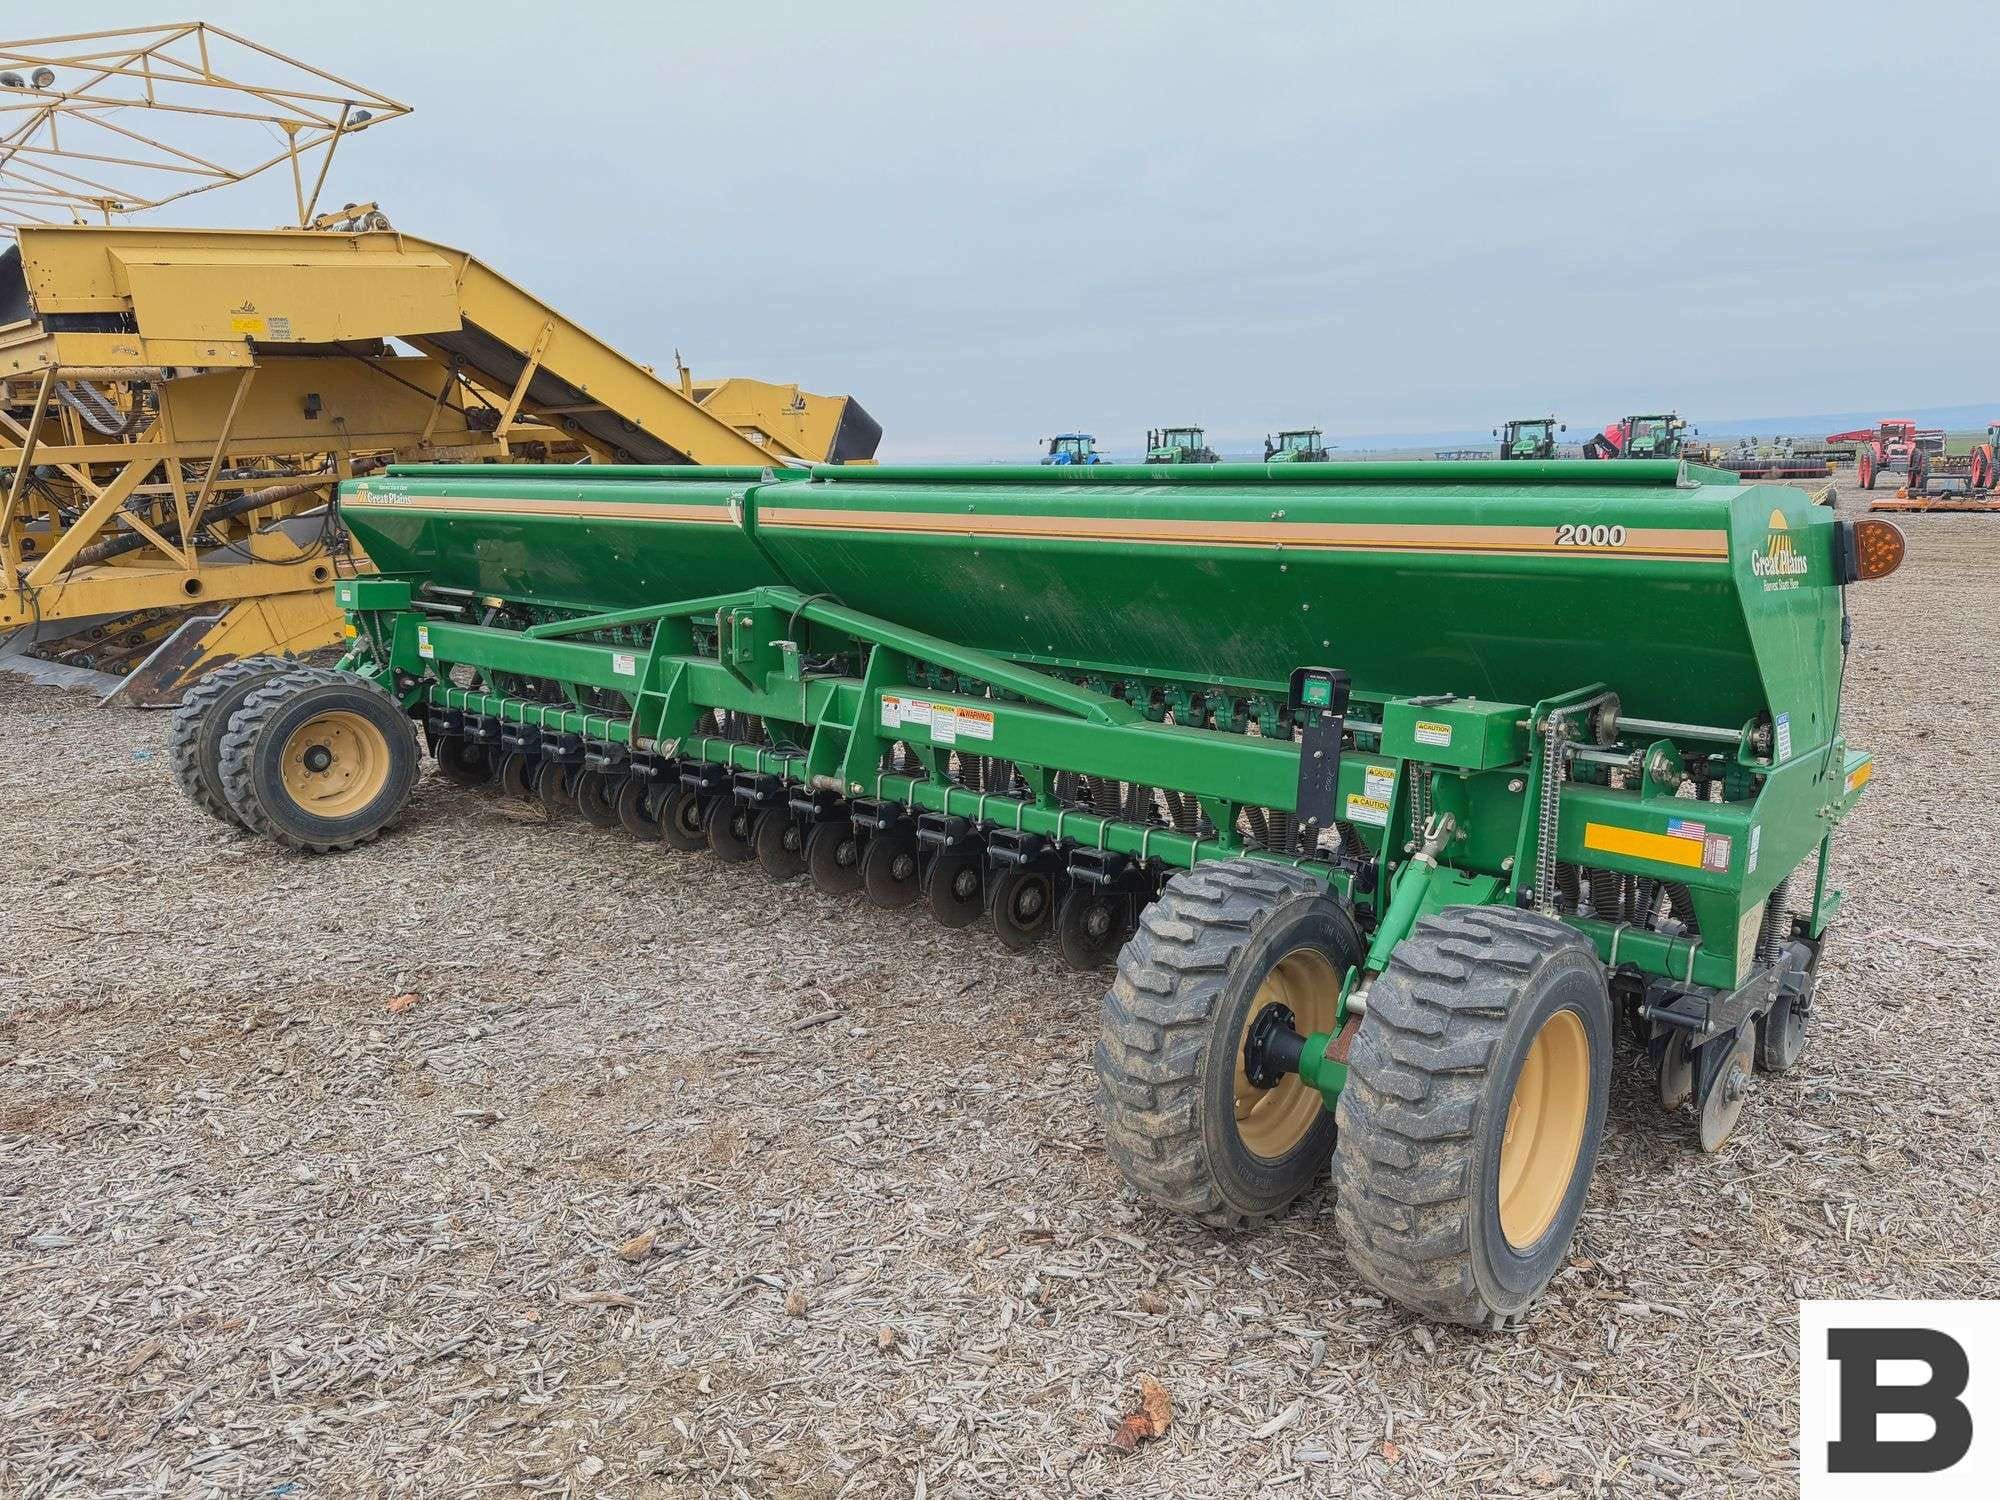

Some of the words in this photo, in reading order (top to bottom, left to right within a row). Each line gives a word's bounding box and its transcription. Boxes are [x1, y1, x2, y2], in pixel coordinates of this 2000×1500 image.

[367, 491, 389, 504] Great
[389, 492, 413, 505] Plains
[1556, 524, 1626, 547] 2000
[1752, 549, 1779, 576] Great
[1780, 549, 1808, 575] Plains
[965, 709, 991, 721] WARNING
[1424, 724, 1449, 732] CAUTION
[1360, 799, 1389, 809] CAUTION
